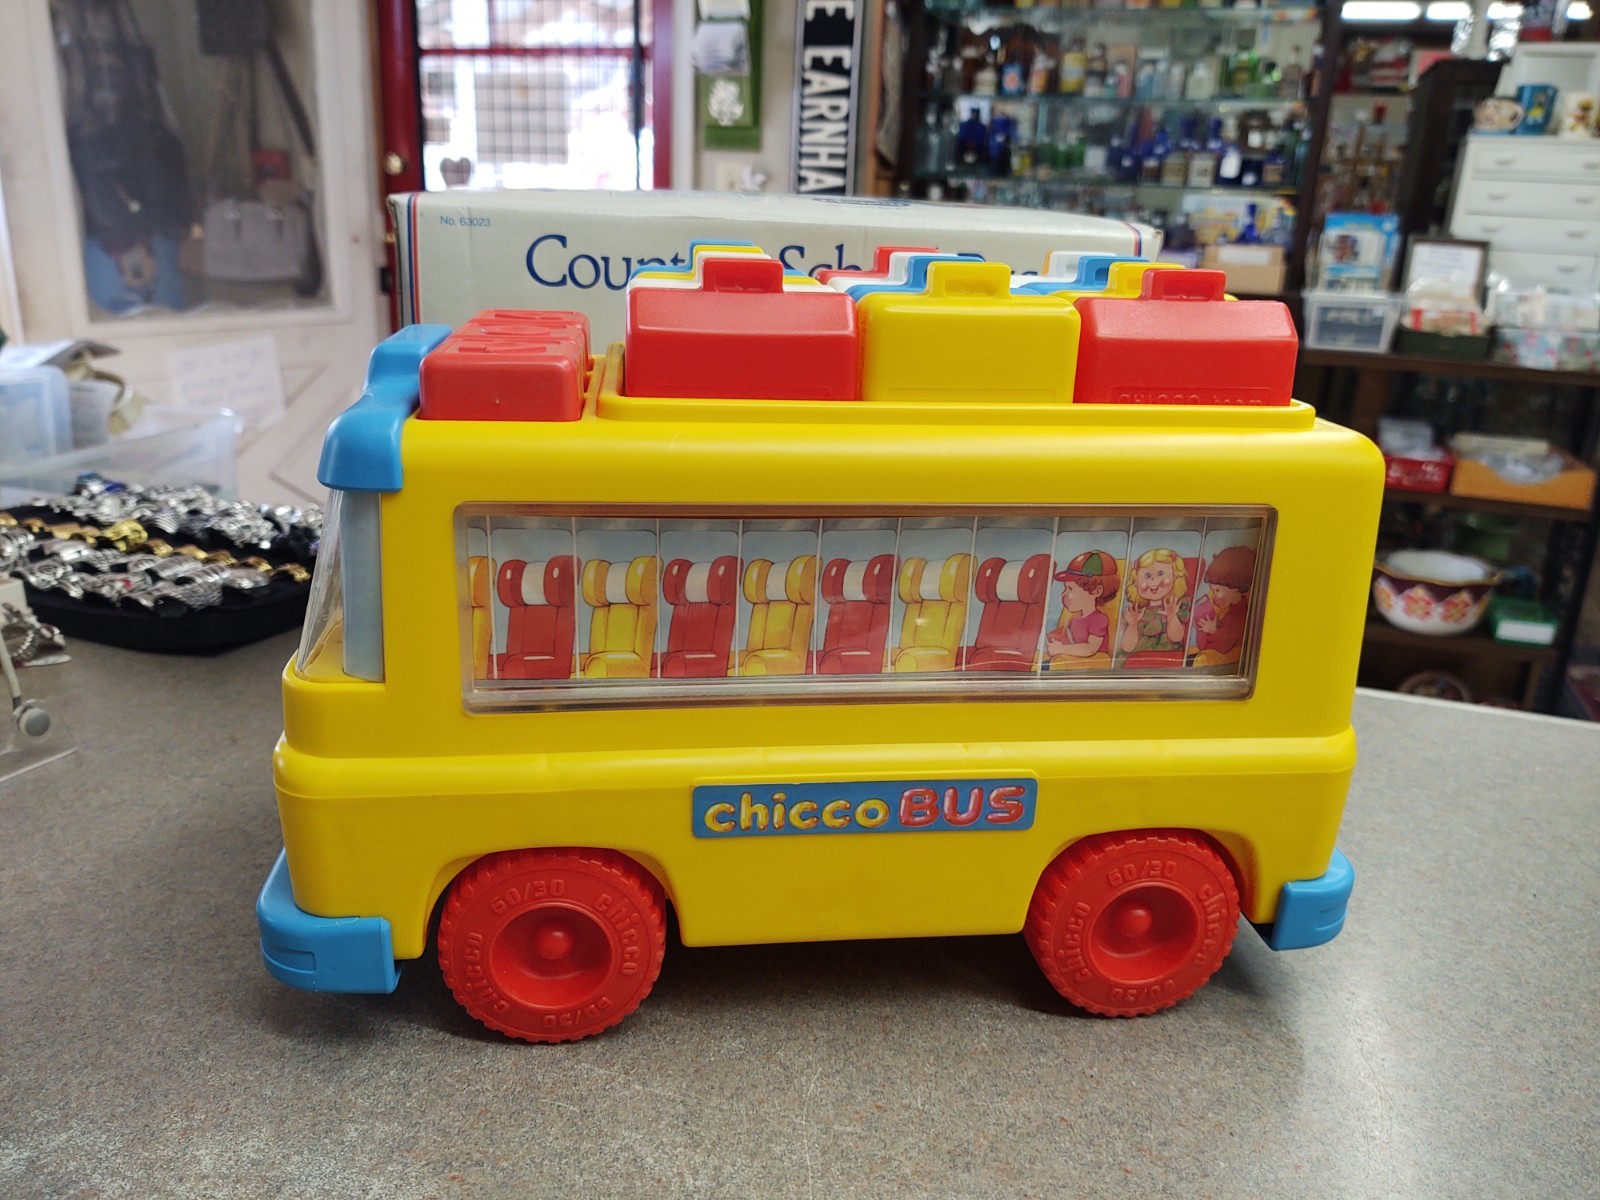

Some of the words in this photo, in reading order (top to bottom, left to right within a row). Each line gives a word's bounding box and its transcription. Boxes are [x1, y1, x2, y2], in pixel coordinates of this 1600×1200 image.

[800, 45, 852, 193] EARNHA
[440, 215, 456, 226] No.
[459, 216, 491, 227] 63023
[526, 234, 686, 291] Cou
[703, 792, 890, 833] chicco
[900, 785, 1026, 828] BUS
